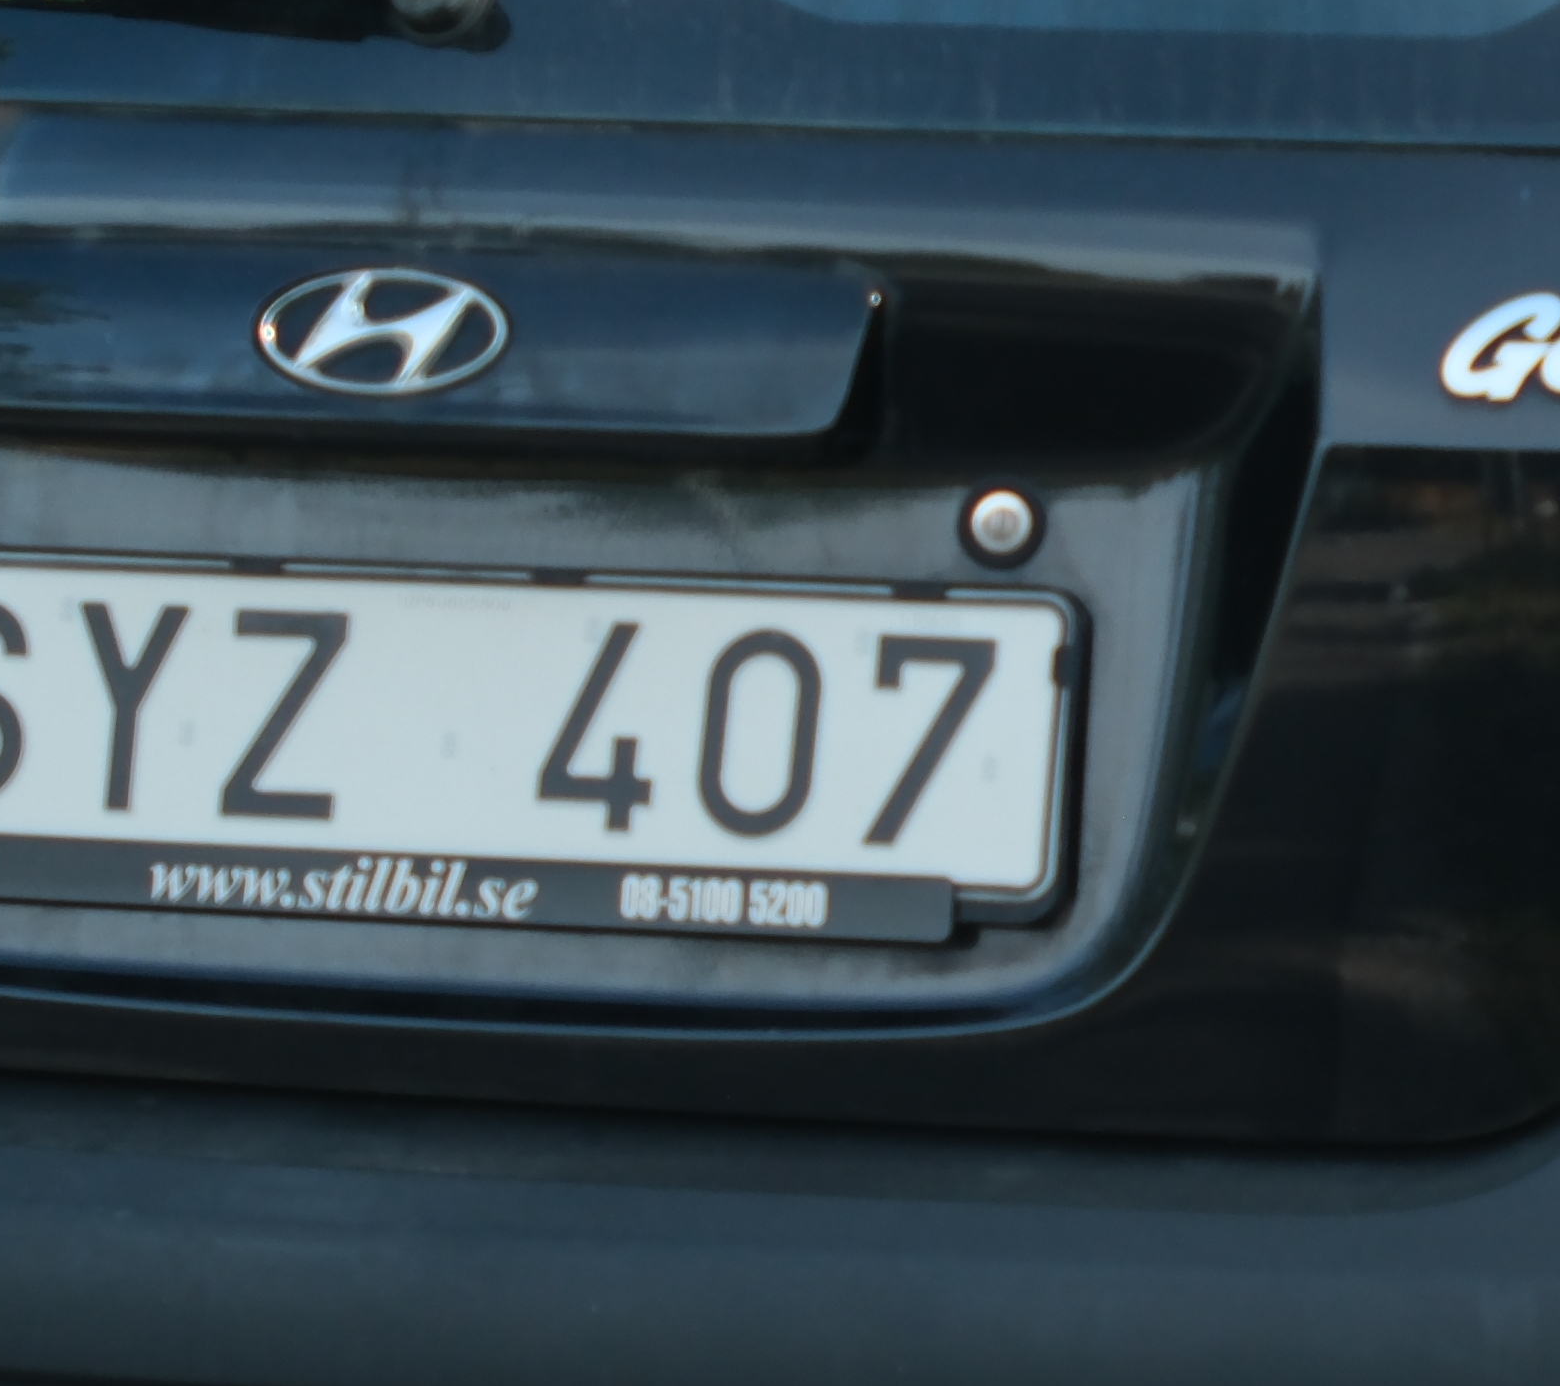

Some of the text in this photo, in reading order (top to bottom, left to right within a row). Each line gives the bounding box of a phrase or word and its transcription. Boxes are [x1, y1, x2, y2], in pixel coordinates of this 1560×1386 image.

[536, 621, 996, 846] 407
[150, 857, 828, 928] www.stilbil.se 08-5100 5200
